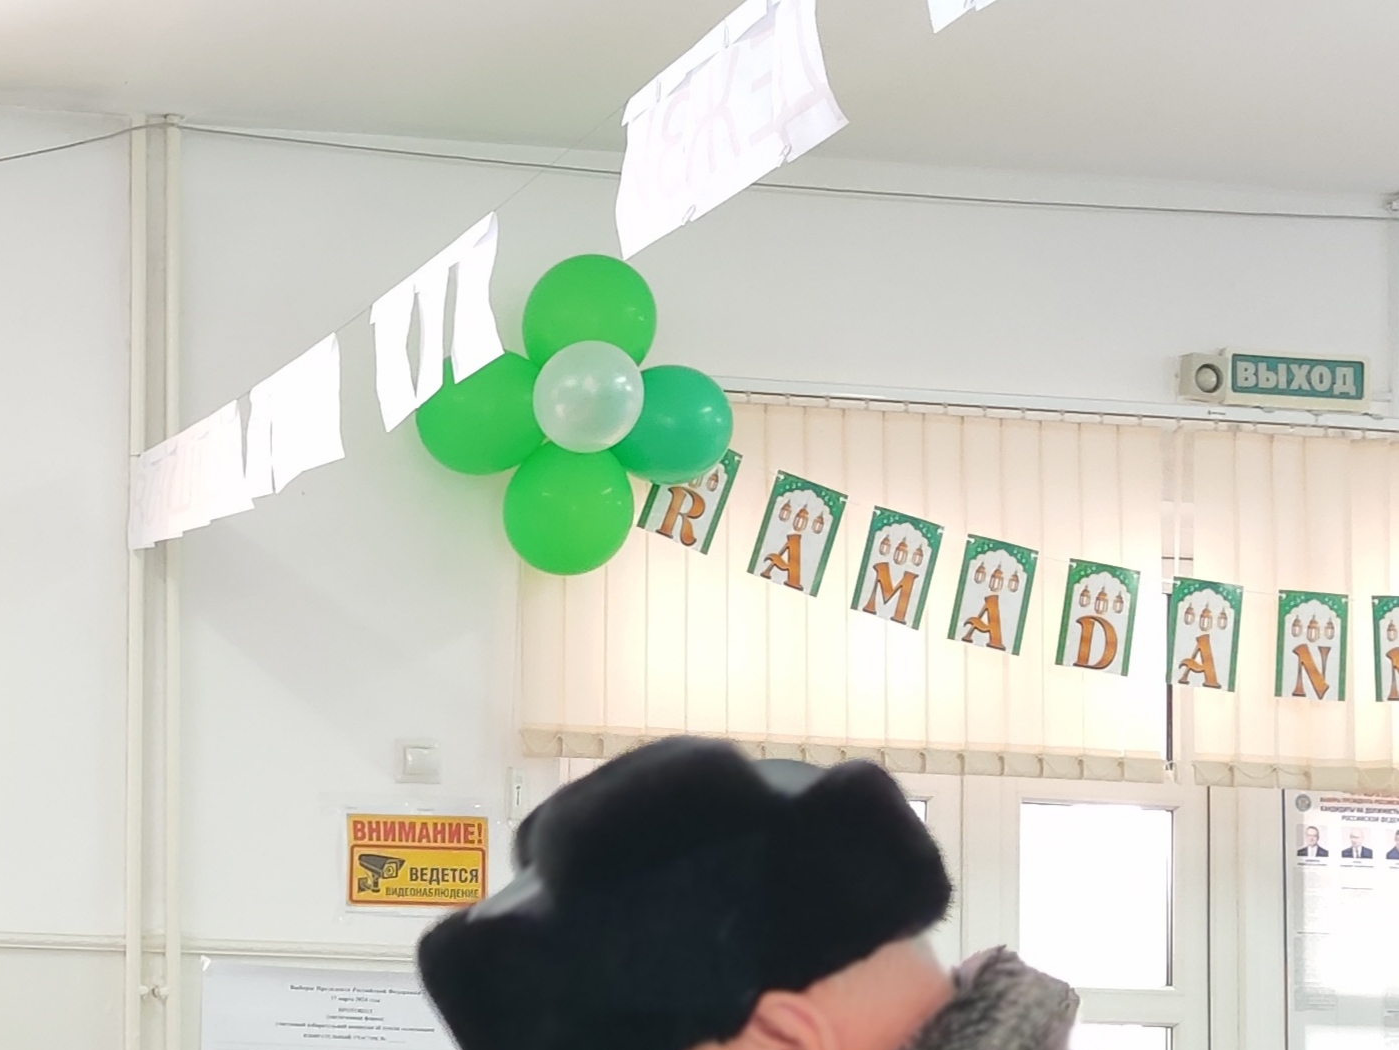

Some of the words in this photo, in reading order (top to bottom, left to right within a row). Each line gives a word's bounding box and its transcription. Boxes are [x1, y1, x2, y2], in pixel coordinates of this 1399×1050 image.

[1236, 360, 1357, 396] ВЫХОД
[655, 485, 1332, 700] RAMADAN
[352, 820, 483, 845] ВНИМАНИЕ!
[409, 866, 479, 886] ВЕДЕТСЯ
[385, 886, 479, 900] ВИДЕОНАБЛЮДЕНИЕ
